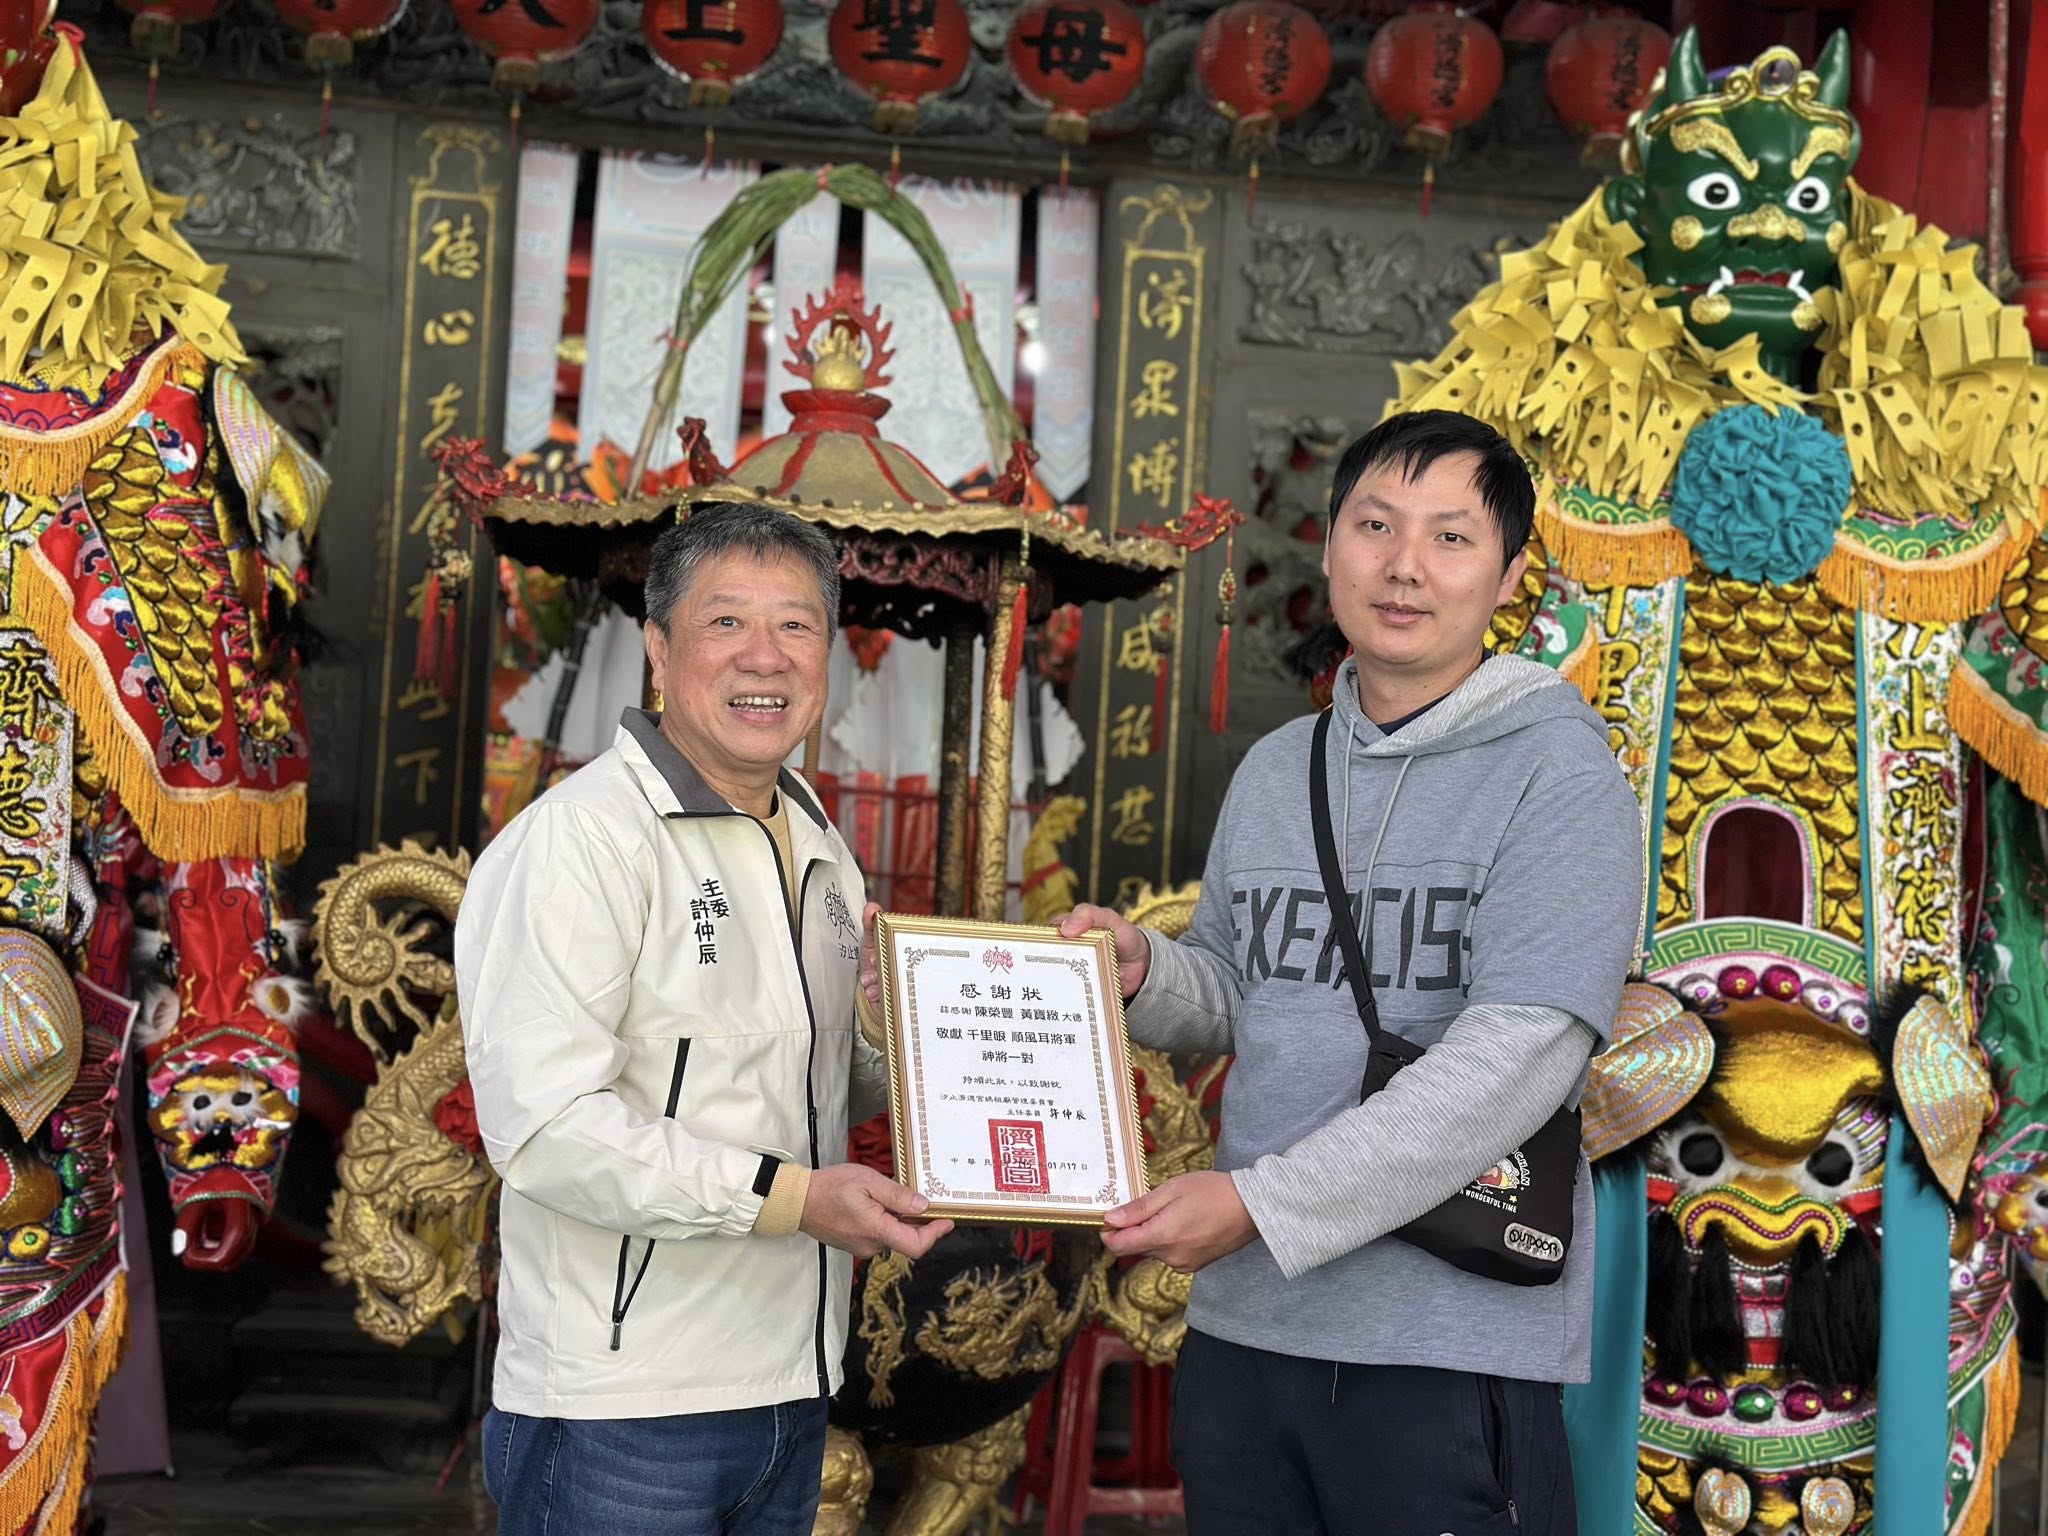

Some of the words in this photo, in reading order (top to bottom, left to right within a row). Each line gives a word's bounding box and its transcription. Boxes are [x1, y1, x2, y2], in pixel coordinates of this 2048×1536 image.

[1021, 8, 1128, 83] 母
[701, 878, 730, 918] 主委
[690, 898, 718, 965] 許仲辰
[960, 982, 1043, 1001] 感謝狀
[975, 1005, 1014, 1019] 陳榮豐
[1062, 1012, 1083, 1022] 大德
[936, 1027, 963, 1040] 敬獻
[967, 1029, 1007, 1042] 千里眼
[1011, 1031, 1077, 1045] 順風耳將軍
[981, 1050, 1034, 1064] 神將一對
[1006, 1109, 1041, 1117] 主任委員
[1049, 1108, 1087, 1120] 許仲辰
[1513, 1148, 1531, 1186] CHAN
[1465, 1189, 1501, 1208] WONDERFUL
[1501, 1201, 1517, 1213] TIME
[1509, 1229, 1558, 1256] OUTDOOR
